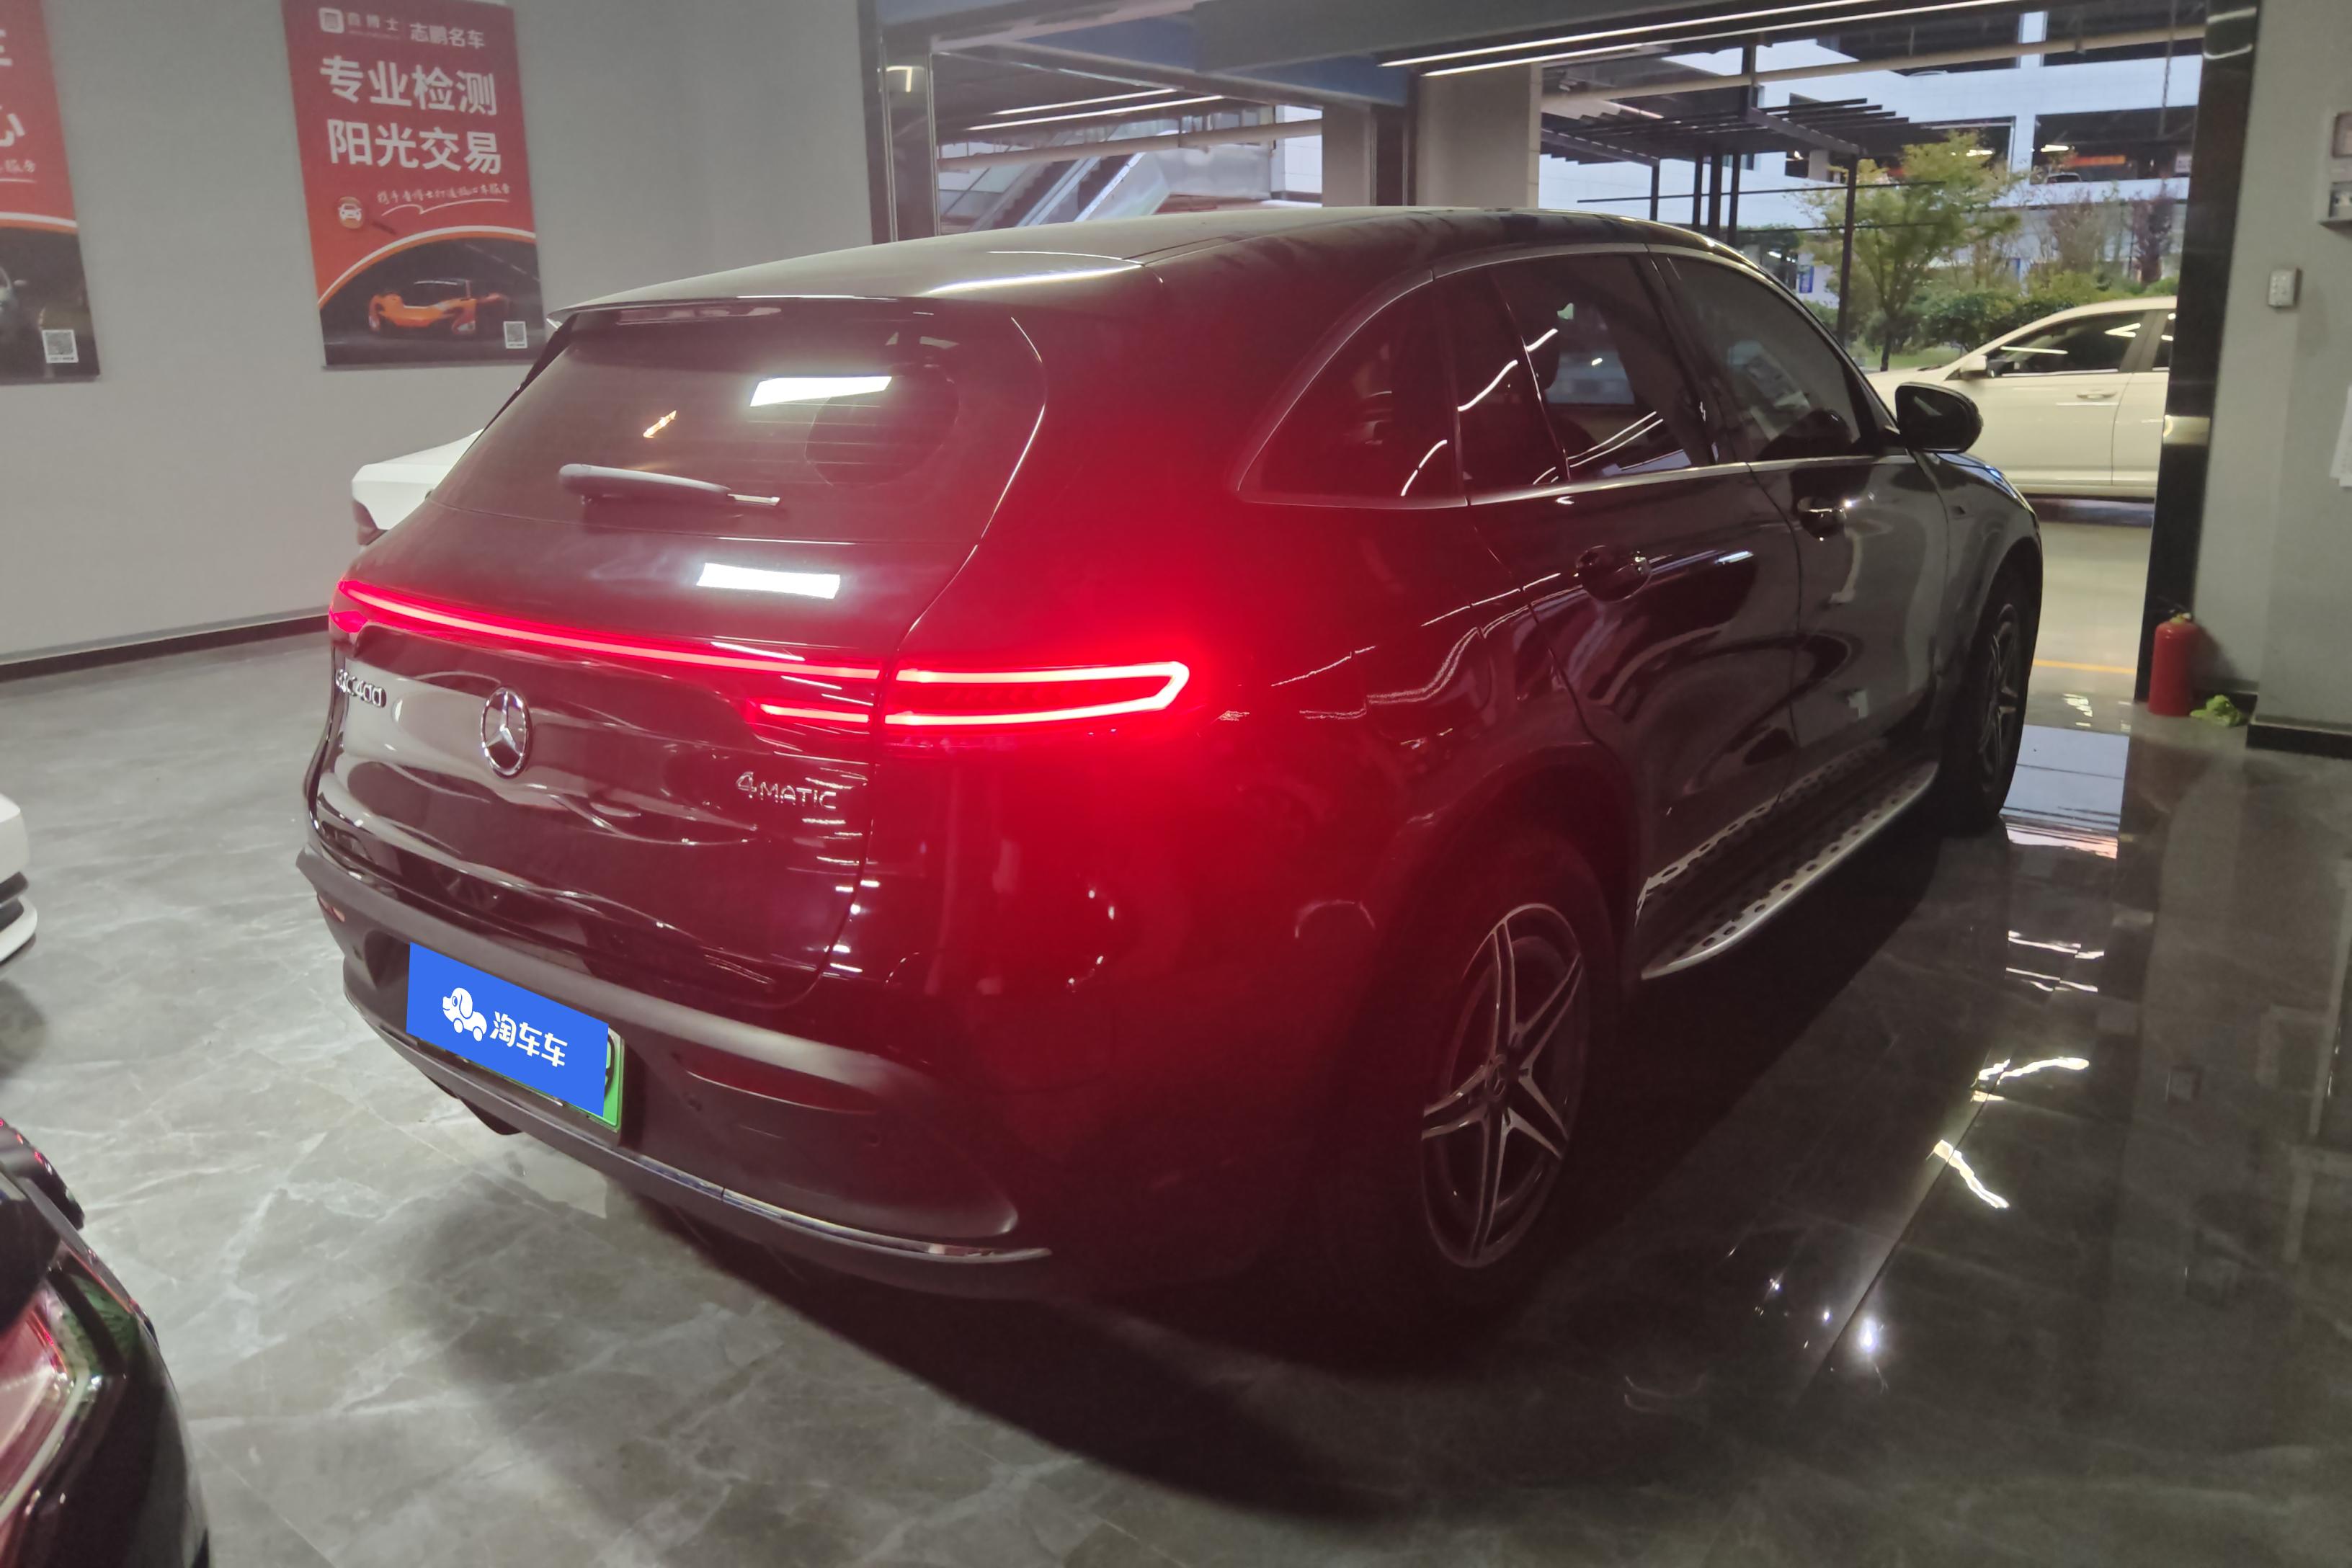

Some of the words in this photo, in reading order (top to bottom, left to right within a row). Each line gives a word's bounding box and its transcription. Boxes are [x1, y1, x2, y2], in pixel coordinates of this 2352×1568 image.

[409, 22, 486, 49] 志鹏名车
[319, 55, 498, 116] 专业检测
[326, 118, 502, 174] 阳光交易
[736, 771, 837, 809] 4MATIC
